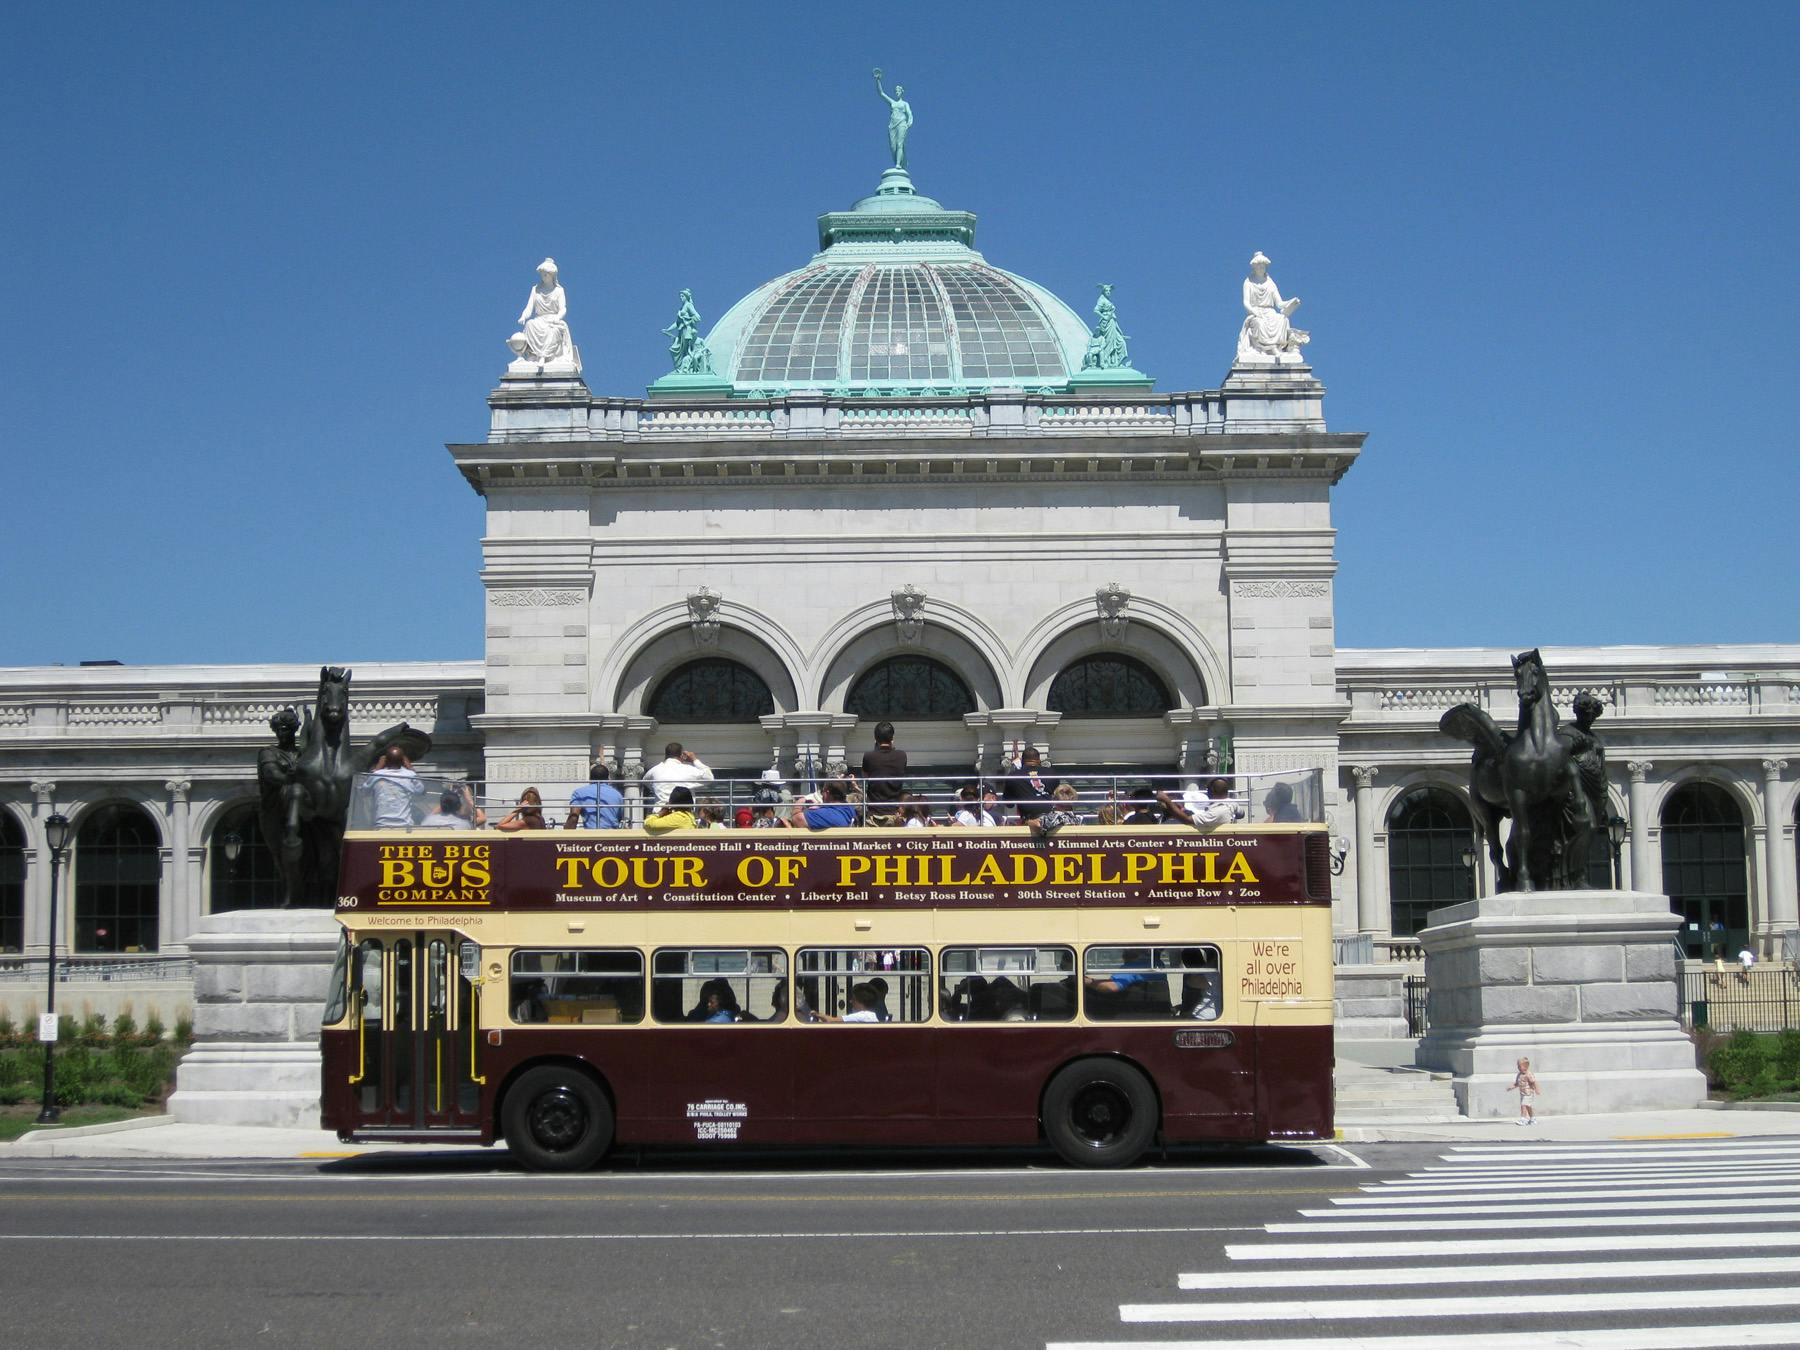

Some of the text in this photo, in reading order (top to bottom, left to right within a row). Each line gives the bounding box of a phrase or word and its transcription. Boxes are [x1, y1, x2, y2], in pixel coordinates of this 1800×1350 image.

[380, 846, 490, 858] THE BIG
[556, 838, 1258, 853] Visitor Center Independence Hall Reading Terminal Market City Hall Rodin Museum Kimmel Arts Center Franklin Court
[378, 860, 490, 888] BUS
[556, 852, 1260, 888] TOUR OF PHILADELPHIA
[338, 897, 358, 907] 360
[378, 890, 490, 900] COMPANY
[556, 894, 602, 902] Museum
[606, 893, 617, 902] of
[664, 893, 734, 901] Constitution
[738, 892, 776, 901] Center
[801, 892, 842, 902] Liberty
[846, 892, 868, 900] Bell
[895, 892, 926, 901] Betsy
[930, 892, 956, 900] Ross
[1018, 891, 1042, 899] 30th
[1046, 890, 1080, 899] Street
[1084, 890, 1126, 898] Station
[1148, 889, 1194, 899] Antique
[1197, 889, 1221, 897] Row
[368, 916, 483, 927] Welcome to Philadelphia
[1253, 941, 1289, 956] We're
[1247, 960, 1296, 975] all over
[1242, 978, 1302, 999] Philadelphia
